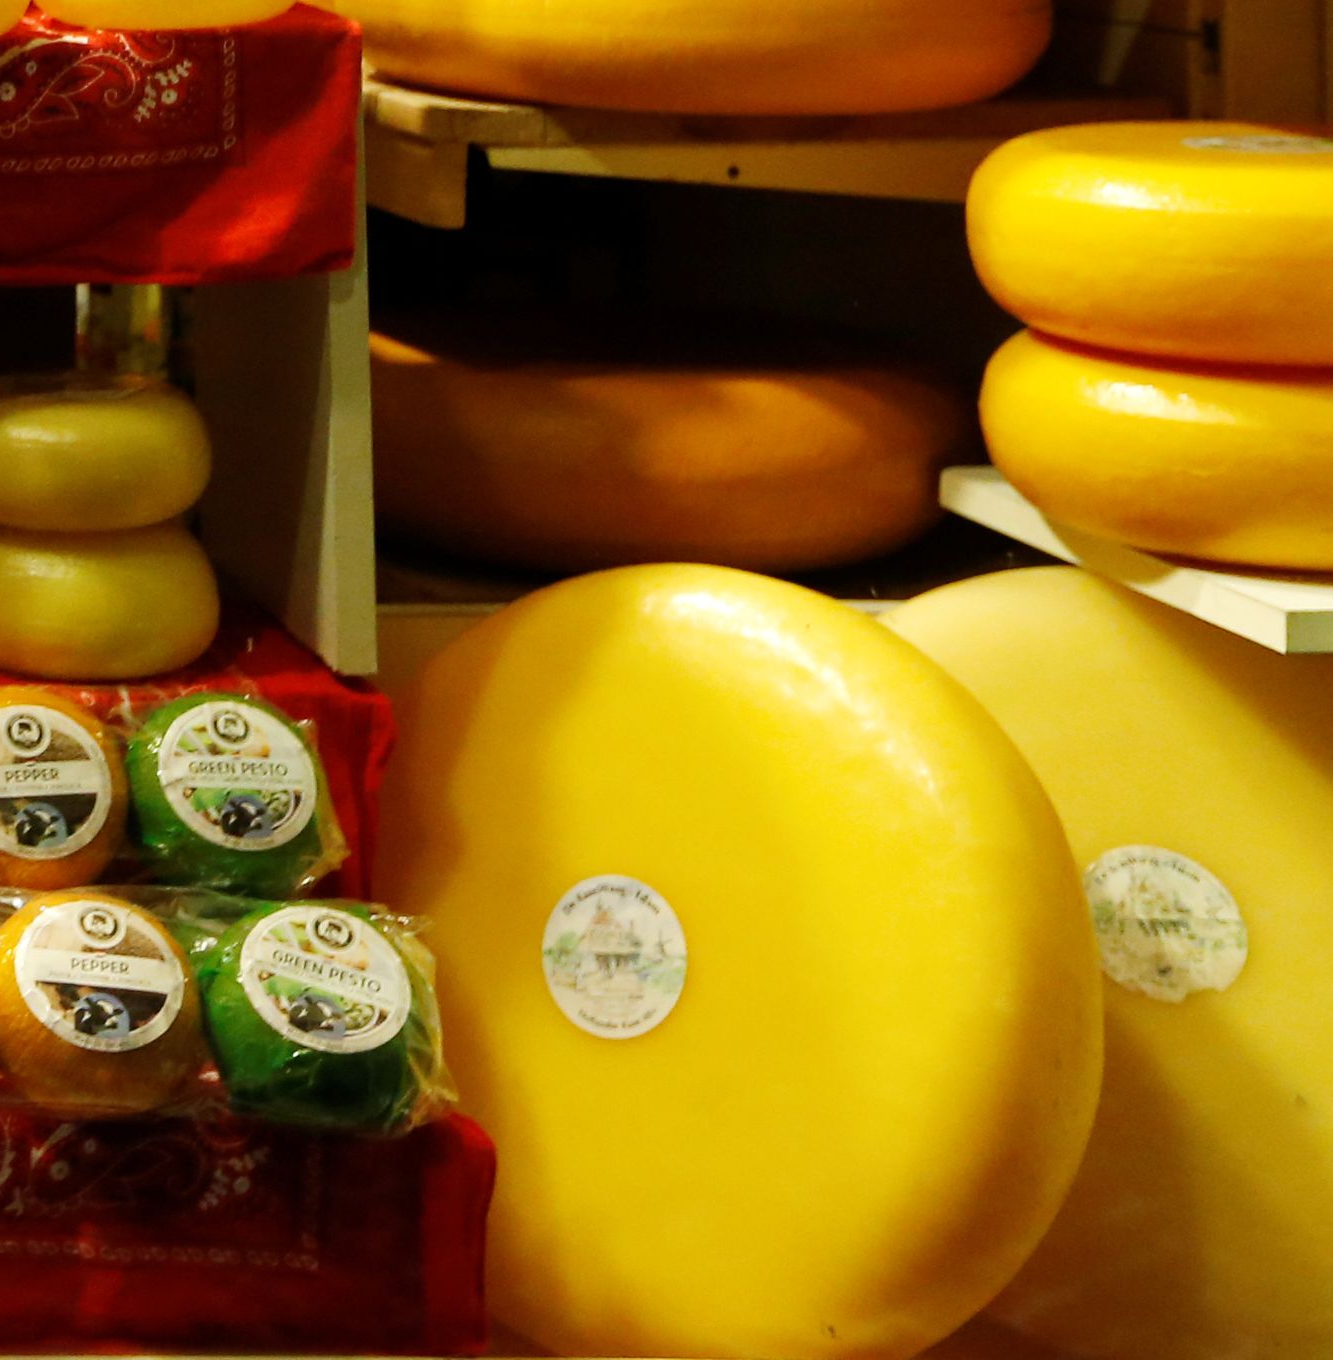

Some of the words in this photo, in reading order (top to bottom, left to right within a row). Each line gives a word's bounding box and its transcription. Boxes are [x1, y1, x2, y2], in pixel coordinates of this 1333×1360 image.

[4, 768, 62, 784] PEPPER
[188, 760, 237, 775] GREEN
[240, 761, 289, 777] PESTO
[69, 957, 130, 975] PEPPER
[272, 948, 324, 975] GREEN
[328, 967, 382, 994] PESTO
